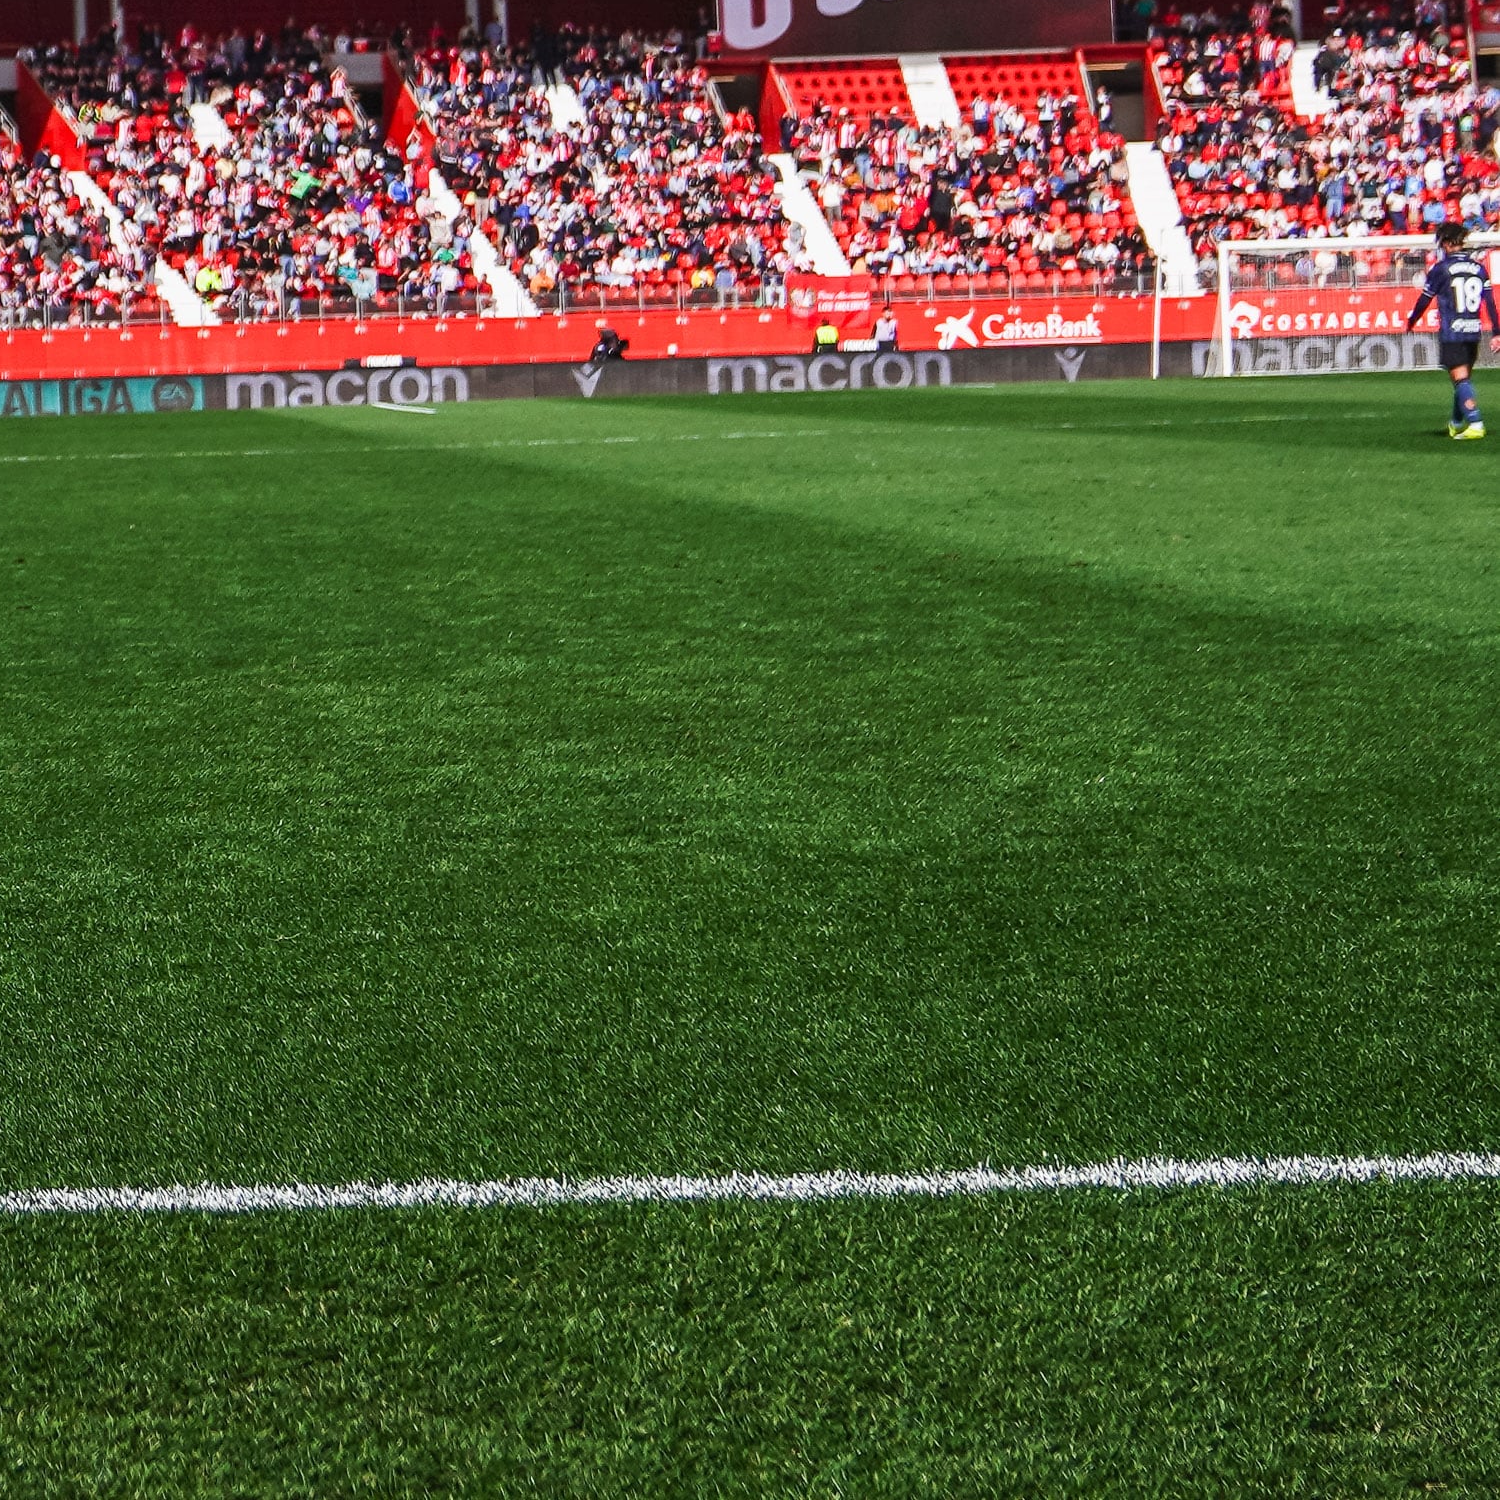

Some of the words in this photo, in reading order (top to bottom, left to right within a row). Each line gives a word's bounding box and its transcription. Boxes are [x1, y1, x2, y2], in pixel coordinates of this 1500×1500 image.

[1451, 277, 1483, 314] 18
[982, 313, 1102, 340] CaixaBank
[707, 351, 951, 395] macron
[1192, 334, 1440, 377] macron
[225, 368, 469, 410] macron
